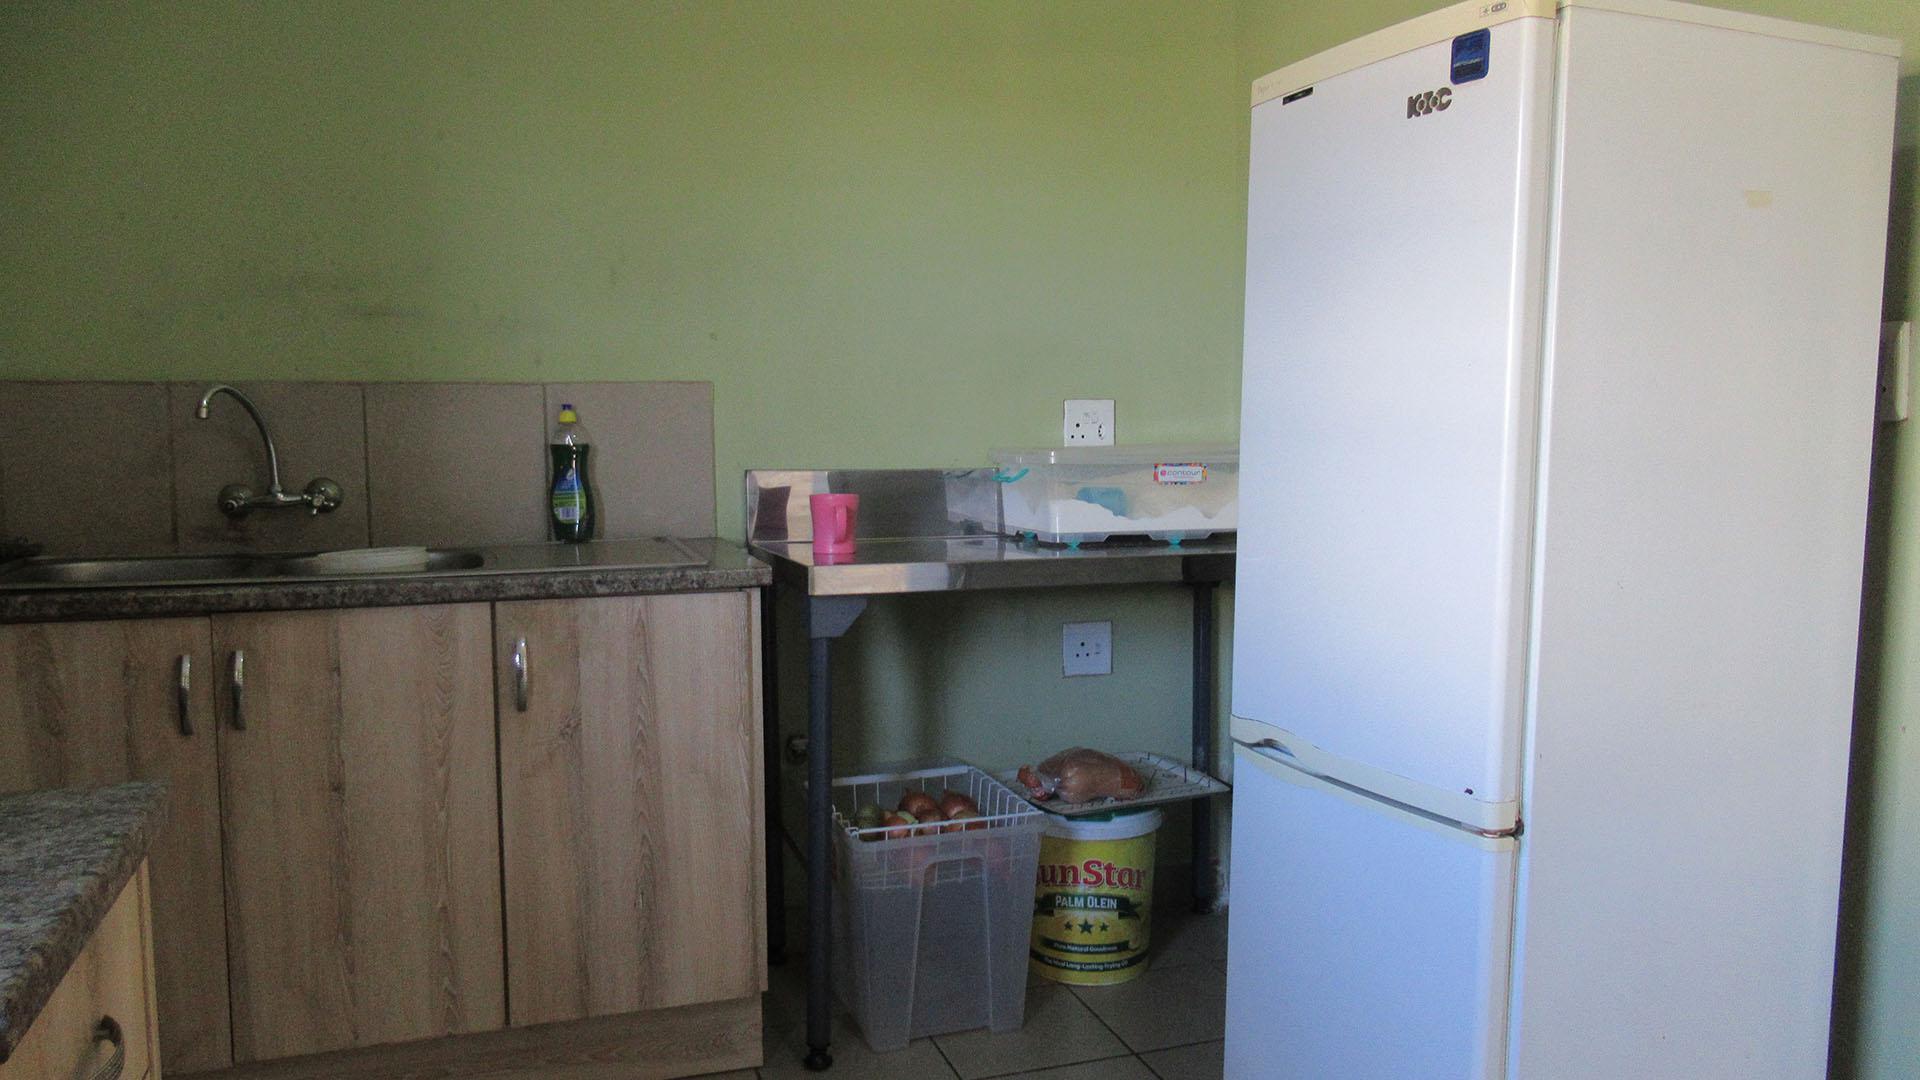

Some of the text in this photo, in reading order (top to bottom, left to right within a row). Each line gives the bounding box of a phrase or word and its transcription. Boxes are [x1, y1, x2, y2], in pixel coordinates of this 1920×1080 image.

[1037, 859, 1146, 889] unStar
[1055, 895, 1117, 909] PALM OLEIN
